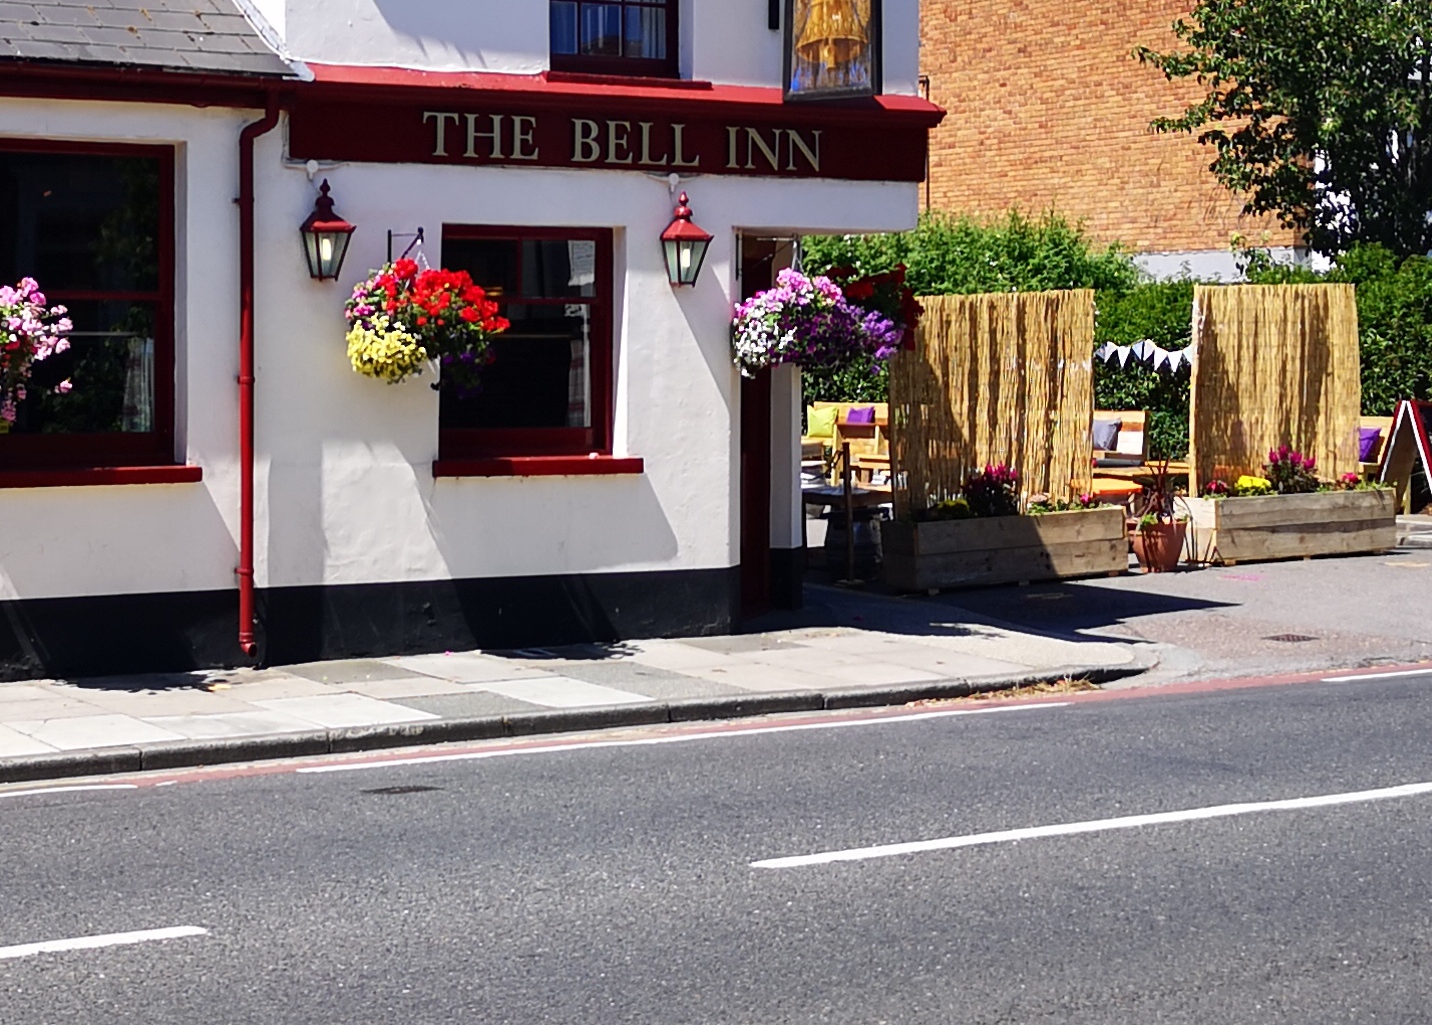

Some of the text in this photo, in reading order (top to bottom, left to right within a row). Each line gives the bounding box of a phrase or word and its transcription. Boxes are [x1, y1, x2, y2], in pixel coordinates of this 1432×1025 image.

[423, 111, 823, 172] THE BELL INN
